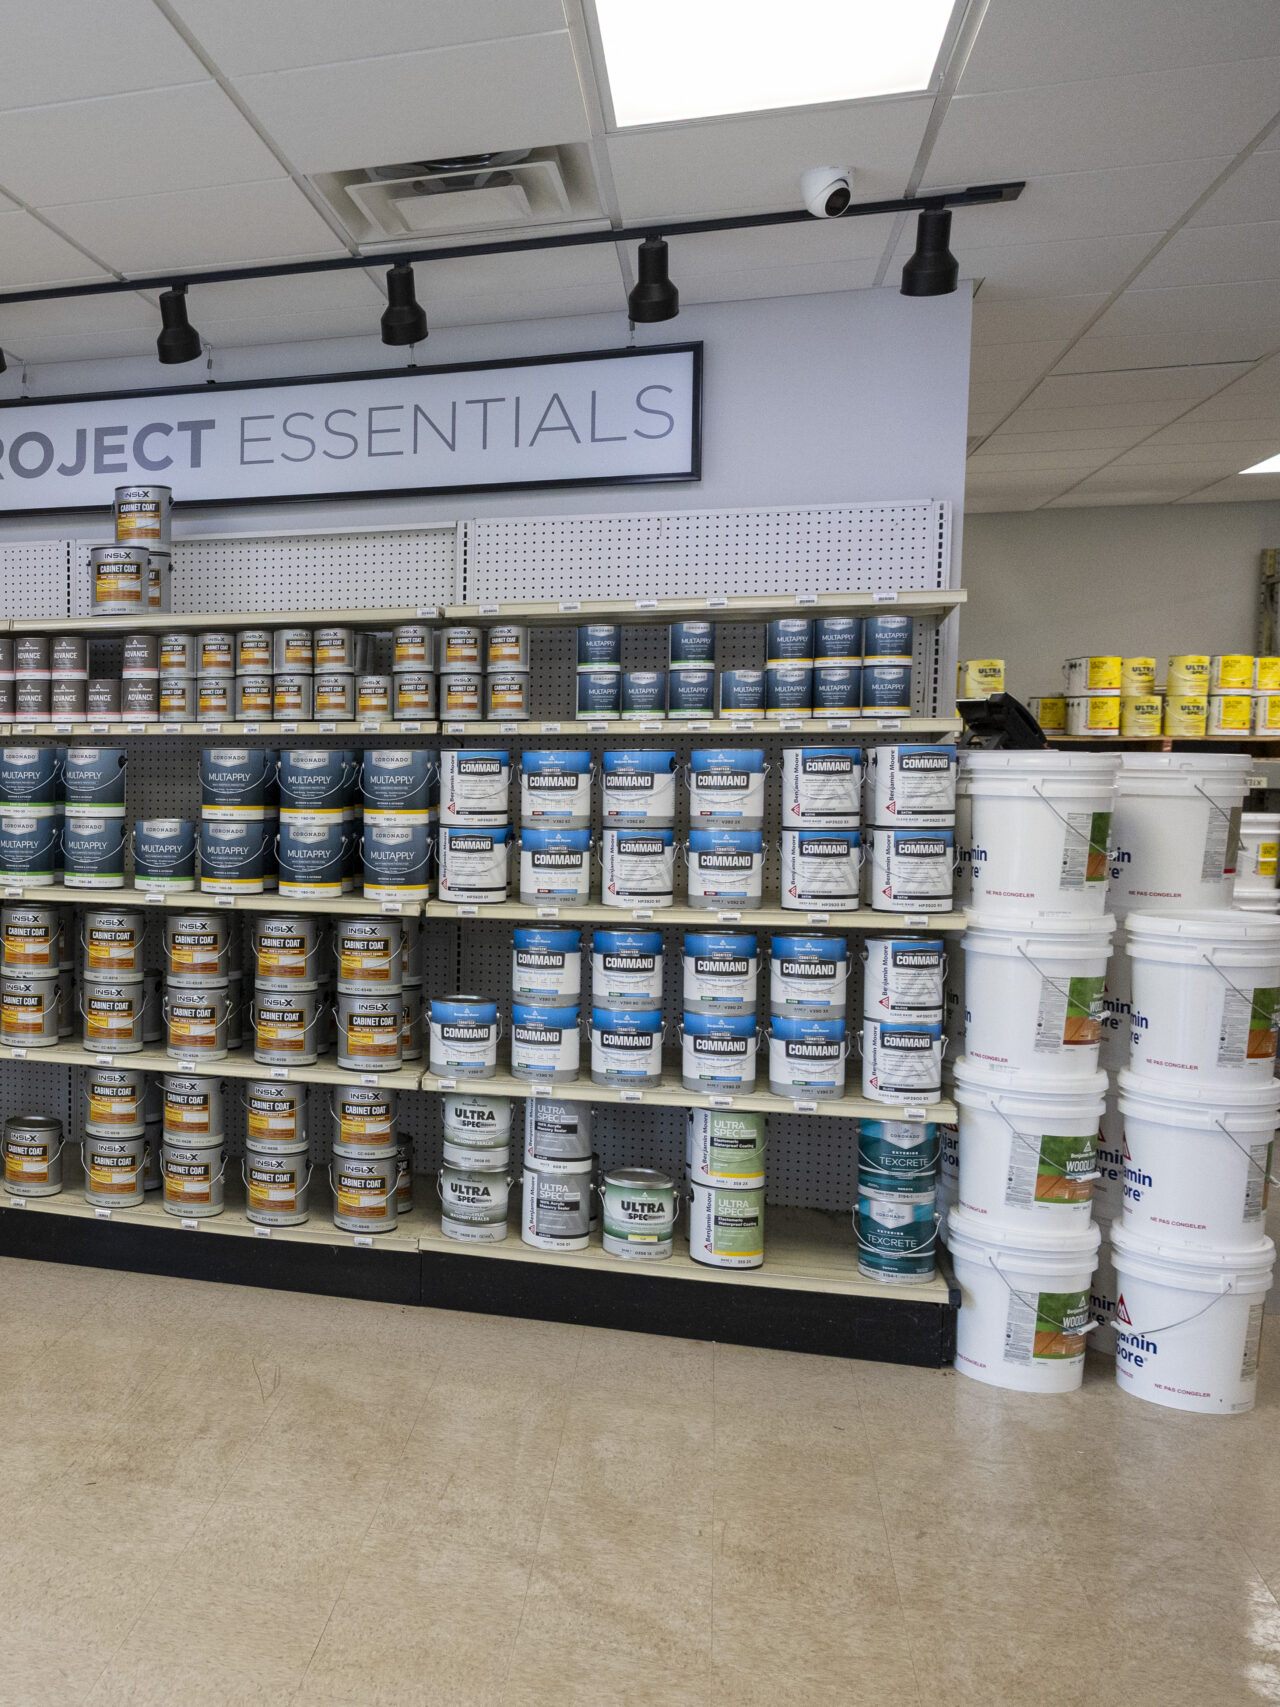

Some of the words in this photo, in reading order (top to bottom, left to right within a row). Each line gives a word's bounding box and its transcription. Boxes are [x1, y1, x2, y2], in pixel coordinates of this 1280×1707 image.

[239, 384, 675, 465] ESSENTIALS
[121, 504, 140, 512] CABINET
[100, 565, 123, 573] CABINET
[806, 762, 850, 771] COMMAND
[2, 771, 41, 780] MULTAPPLY
[209, 773, 250, 782] MULTAPPLY
[288, 775, 331, 784] MULTAPPLY
[370, 775, 413, 784] MULTAPPLY
[530, 776, 576, 786] COMMAND
[697, 775, 747, 787] COMMAND
[1, 839, 39, 849] MULTAPPLY
[69, 841, 108, 850] MULTAPPLY
[451, 840, 491, 850] COMMAND
[141, 845, 183, 853] MULTAPPLY
[899, 844, 944, 854] COMMAND
[288, 850, 331, 859] MULTAPPLY
[371, 851, 415, 860] MULTAPPLY
[534, 854, 581, 865] COMMAND
[700, 855, 751, 867] COMMAND
[12, 915, 41, 923] INSL-X
[8, 927, 30, 935] CABINET
[32, 928, 45, 936] COAT
[266, 925, 295, 933] INSL-X
[262, 938, 284, 947] CABINET
[285, 939, 300, 947] COAT
[518, 954, 562, 966] COMMAND
[606, 957, 653, 969] COMMAND
[697, 961, 747, 972] COMMAND
[783, 963, 834, 975] COMMAND
[359, 1003, 390, 1011] INSL-X
[353, 1016, 376, 1026] CABINET
[377, 1017, 394, 1025] COAT
[443, 1027, 488, 1039] COMMAND
[515, 1030, 559, 1042] COMMAND
[603, 1035, 650, 1046] COMMAND
[696, 1040, 746, 1052] COMMAND
[788, 1044, 839, 1056] COMMAND
[98, 1074, 127, 1082] INSL-X
[94, 1086, 116, 1095] CABINET
[118, 1087, 132, 1095] COAT
[255, 1088, 284, 1097] INSL-X
[251, 1100, 273, 1110] CABINET
[275, 1102, 290, 1110] COAT
[537, 1105, 565, 1114] ULTRA
[455, 1108, 495, 1120] ULTRA
[537, 1114, 559, 1122] SPEC
[462, 1120, 480, 1128] SPEC
[714, 1120, 745, 1129] ULTRA
[714, 1129, 739, 1137] SPEC
[880, 1157, 929, 1167] TEXCRETE
[345, 1166, 375, 1174] INSL-X
[341, 1176, 365, 1188] CABINET
[366, 1179, 381, 1188] COAT
[451, 1183, 491, 1196] ULTRA
[540, 1183, 568, 1192] ULTRA
[458, 1195, 476, 1203] SPEC
[719, 1199, 749, 1208] ULTRA
[621, 1201, 665, 1213] ULTRA
[718, 1208, 743, 1216] SPEC
[876, 1212, 905, 1220] CORONADO
[1171, 1221, 1206, 1230] CONGELER
[867, 1234, 917, 1248] TEXCRETE
[1177, 1389, 1211, 1397] CONGELER
